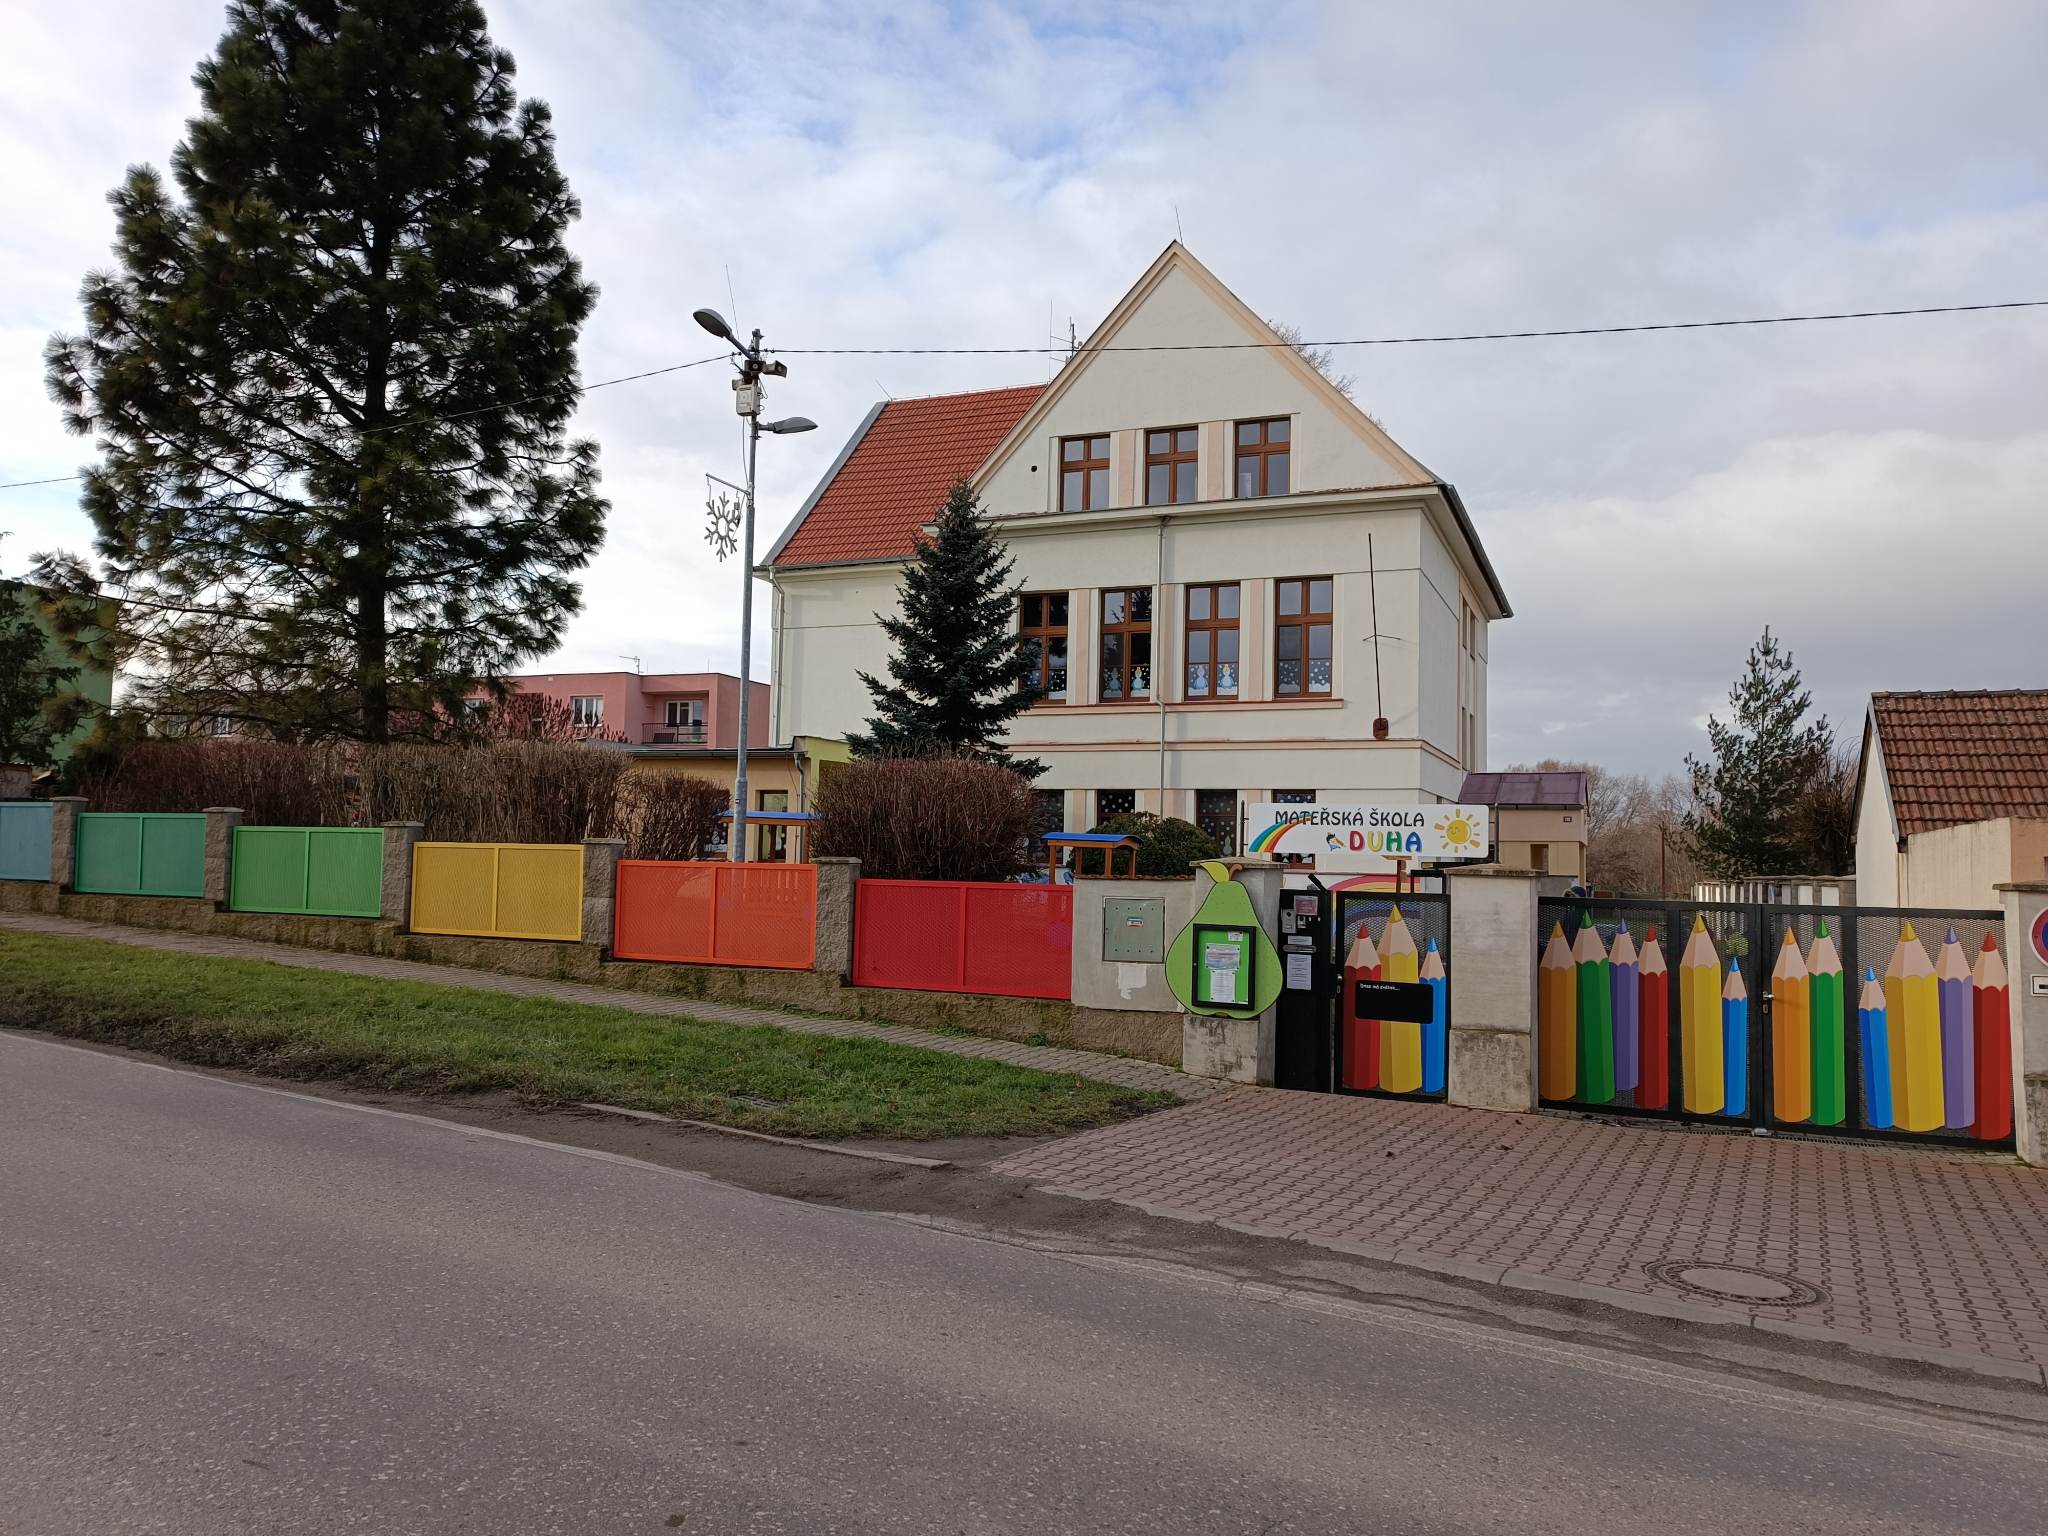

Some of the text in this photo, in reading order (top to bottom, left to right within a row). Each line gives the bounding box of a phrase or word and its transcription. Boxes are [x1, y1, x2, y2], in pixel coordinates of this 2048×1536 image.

[1275, 808, 1425, 827] MATEŘSKÁ ŠKOLA
[1349, 831, 1423, 852] DUHA
